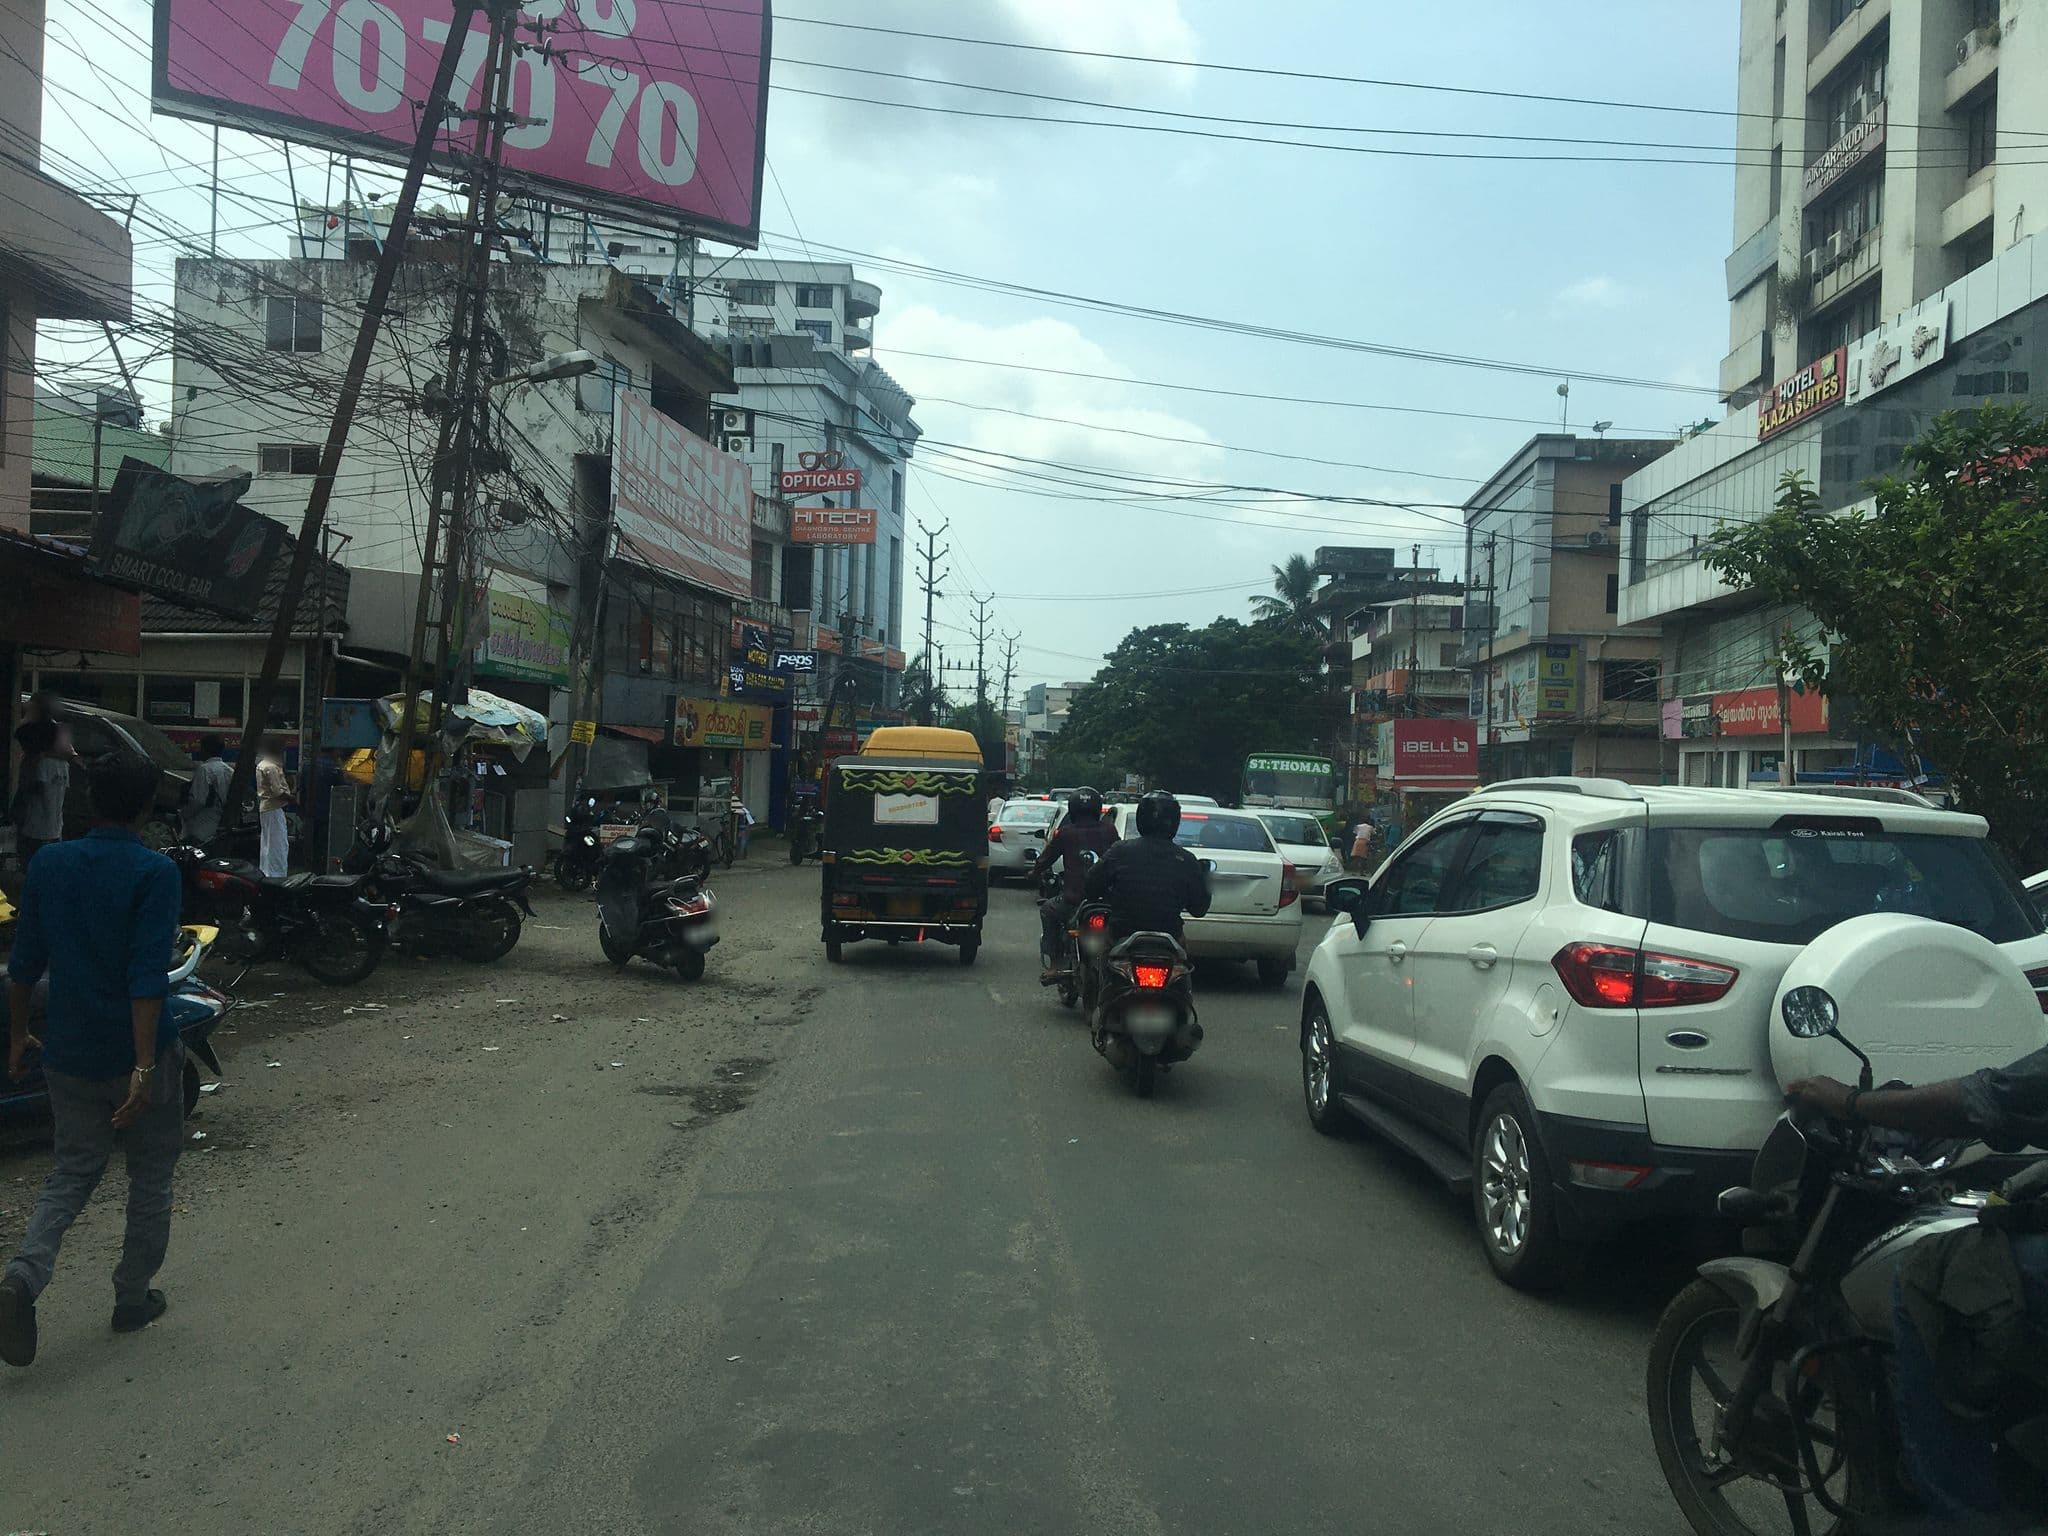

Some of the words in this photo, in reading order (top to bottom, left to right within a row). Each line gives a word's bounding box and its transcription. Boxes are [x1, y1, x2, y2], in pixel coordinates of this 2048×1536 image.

[577, 59, 699, 186] 70
[1759, 401, 1794, 432] PLAZA
[1795, 375, 1838, 413] SUITES
[1780, 368, 1815, 402] HOTEL
[625, 402, 750, 527] MEGHA
[782, 473, 856, 488] OPTICALS
[624, 472, 700, 533] GRANITES
[715, 514, 751, 551] TILES
[794, 511, 812, 524] HI
[815, 511, 871, 524] TECH
[111, 553, 157, 583] SMART
[156, 567, 186, 592] COOL
[188, 577, 213, 598] BAR
[1402, 741, 1450, 753] iBELL
